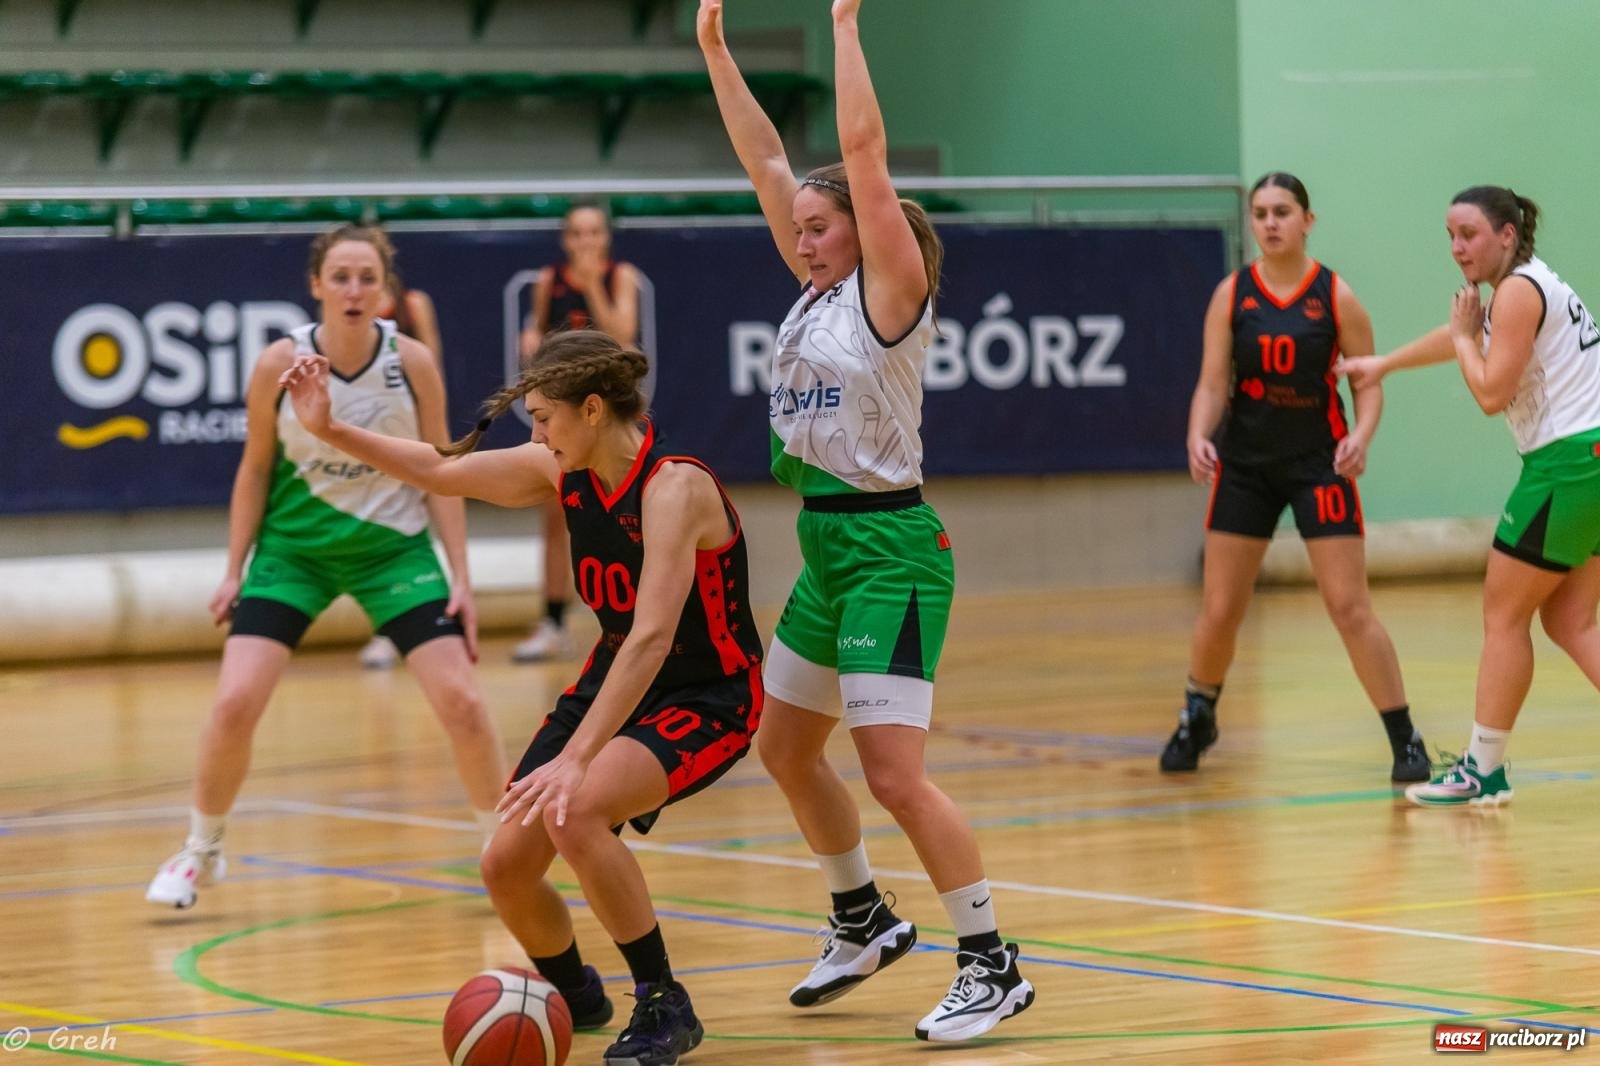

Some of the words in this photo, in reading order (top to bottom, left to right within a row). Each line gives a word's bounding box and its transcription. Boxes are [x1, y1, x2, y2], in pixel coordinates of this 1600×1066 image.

[728, 293, 1127, 394] RBÓRZ
[1258, 334, 1296, 374] 10
[1313, 484, 1346, 524] 10
[579, 556, 637, 613] 00
